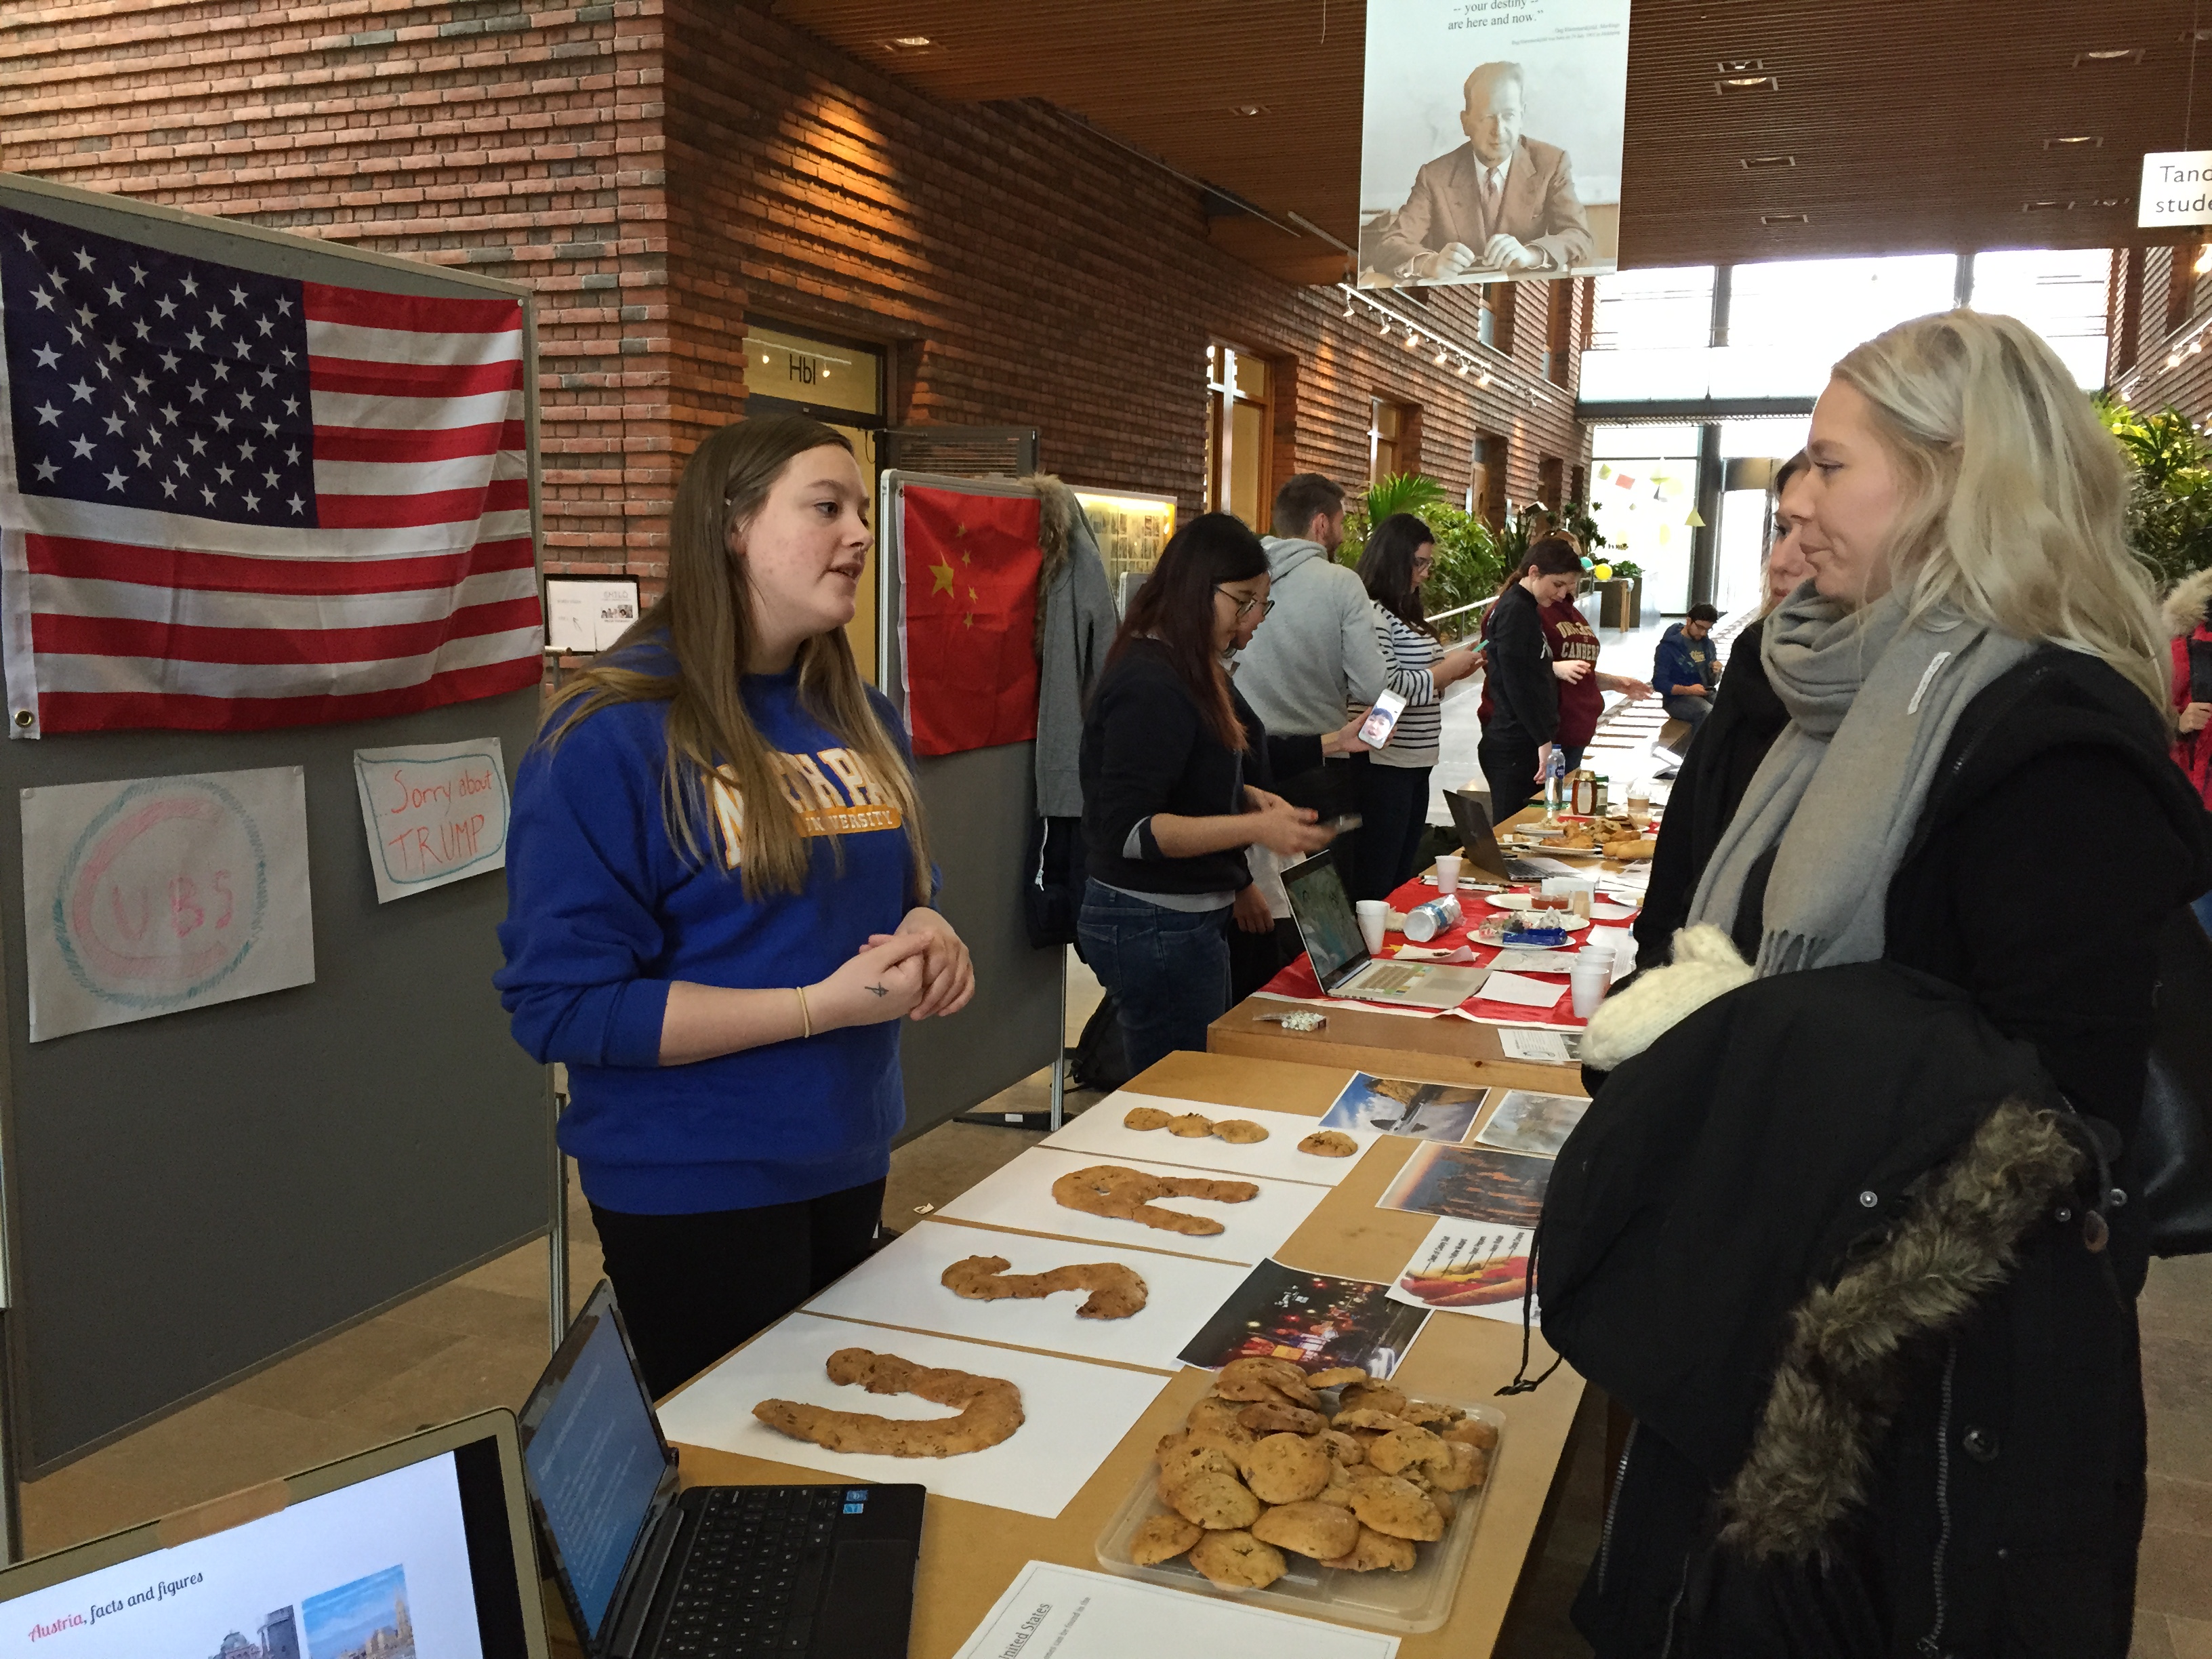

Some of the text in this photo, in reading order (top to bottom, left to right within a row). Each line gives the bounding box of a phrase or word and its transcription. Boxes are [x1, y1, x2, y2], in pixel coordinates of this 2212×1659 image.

[1448, 21, 1463, 30] are
[1466, 18, 1488, 28] here
[1491, 14, 1509, 25] and
[1465, 2, 1488, 15] your
[391, 768, 493, 816] Sorry about
[388, 814, 485, 874] TRUMP
[28, 1572, 203, 1642] Austria, facts and figures
[1021, 1602, 1050, 1632] States
